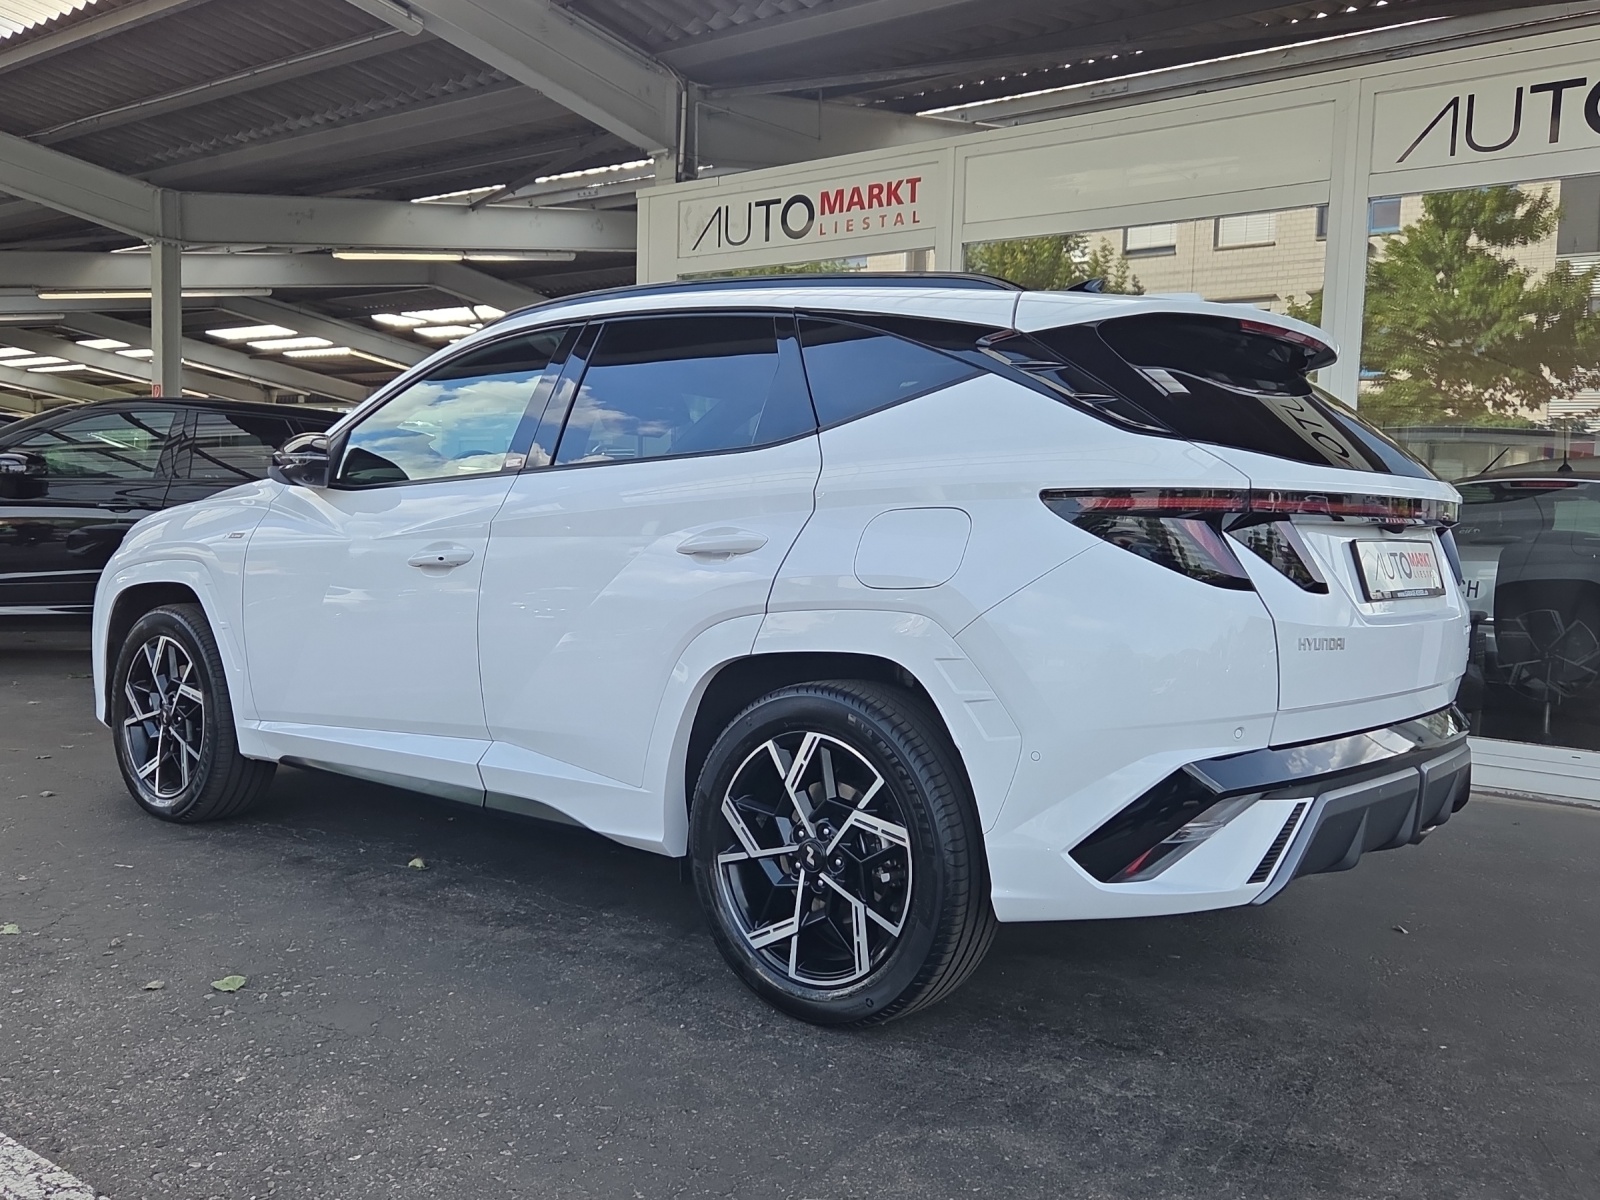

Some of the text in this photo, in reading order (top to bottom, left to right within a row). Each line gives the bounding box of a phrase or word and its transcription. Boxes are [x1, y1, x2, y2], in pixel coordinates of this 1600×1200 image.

[1396, 77, 1600, 163] AUT
[692, 177, 922, 251] AUTO MARKT
[819, 211, 921, 236] LIESTAL
[1375, 552, 1432, 581] AUTO MARKT
[1298, 637, 1346, 651] HYUNDAI
